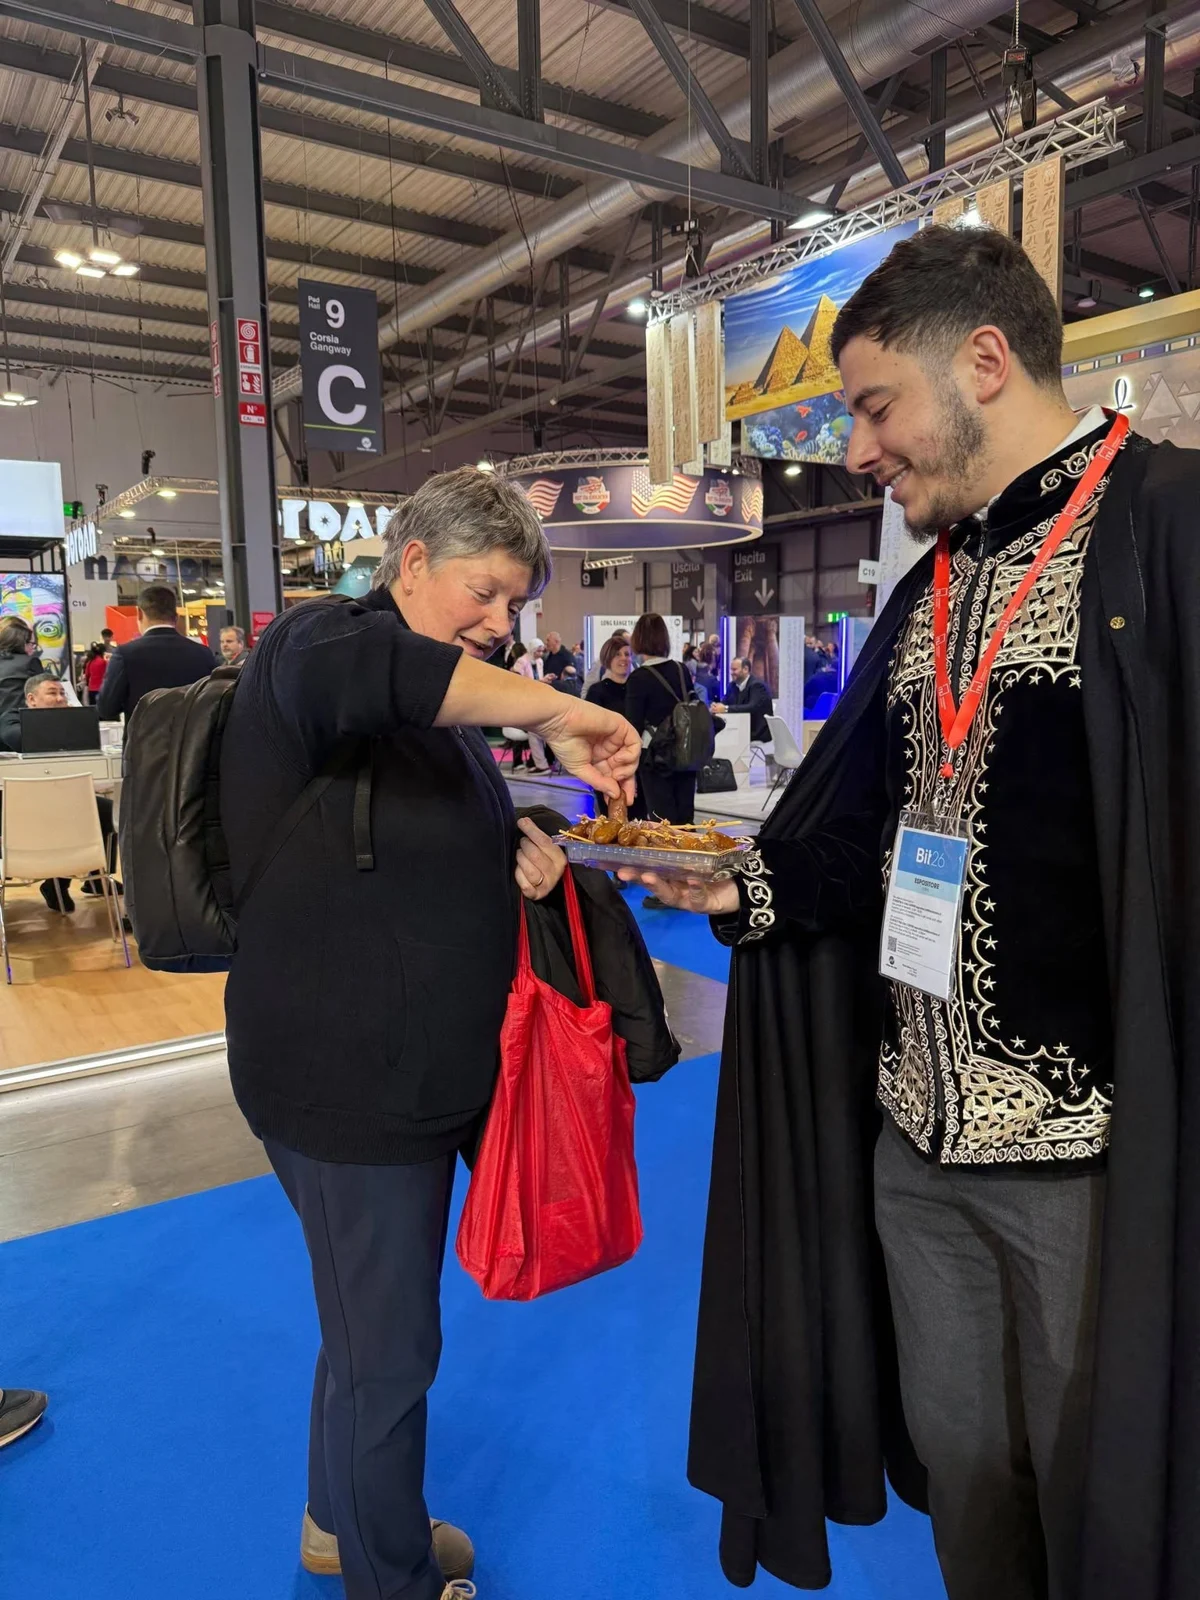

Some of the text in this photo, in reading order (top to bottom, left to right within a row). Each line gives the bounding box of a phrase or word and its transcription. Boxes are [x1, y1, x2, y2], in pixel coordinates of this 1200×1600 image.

[308, 302, 321, 310] Hall
[325, 299, 345, 329] 9
[309, 331, 340, 344] Corsia
[309, 341, 352, 357] Gangway
[317, 364, 367, 426] C
[734, 550, 766, 566] Uscita
[582, 572, 591, 585] 9
[734, 569, 753, 583] Exit
[862, 567, 876, 577] C19
[673, 577, 689, 590] Exit
[72, 600, 87, 608] C16
[600, 619, 613, 627] LONG
[613, 619, 627, 627] RANGE
[914, 877, 940, 890] ESPOSITORE
